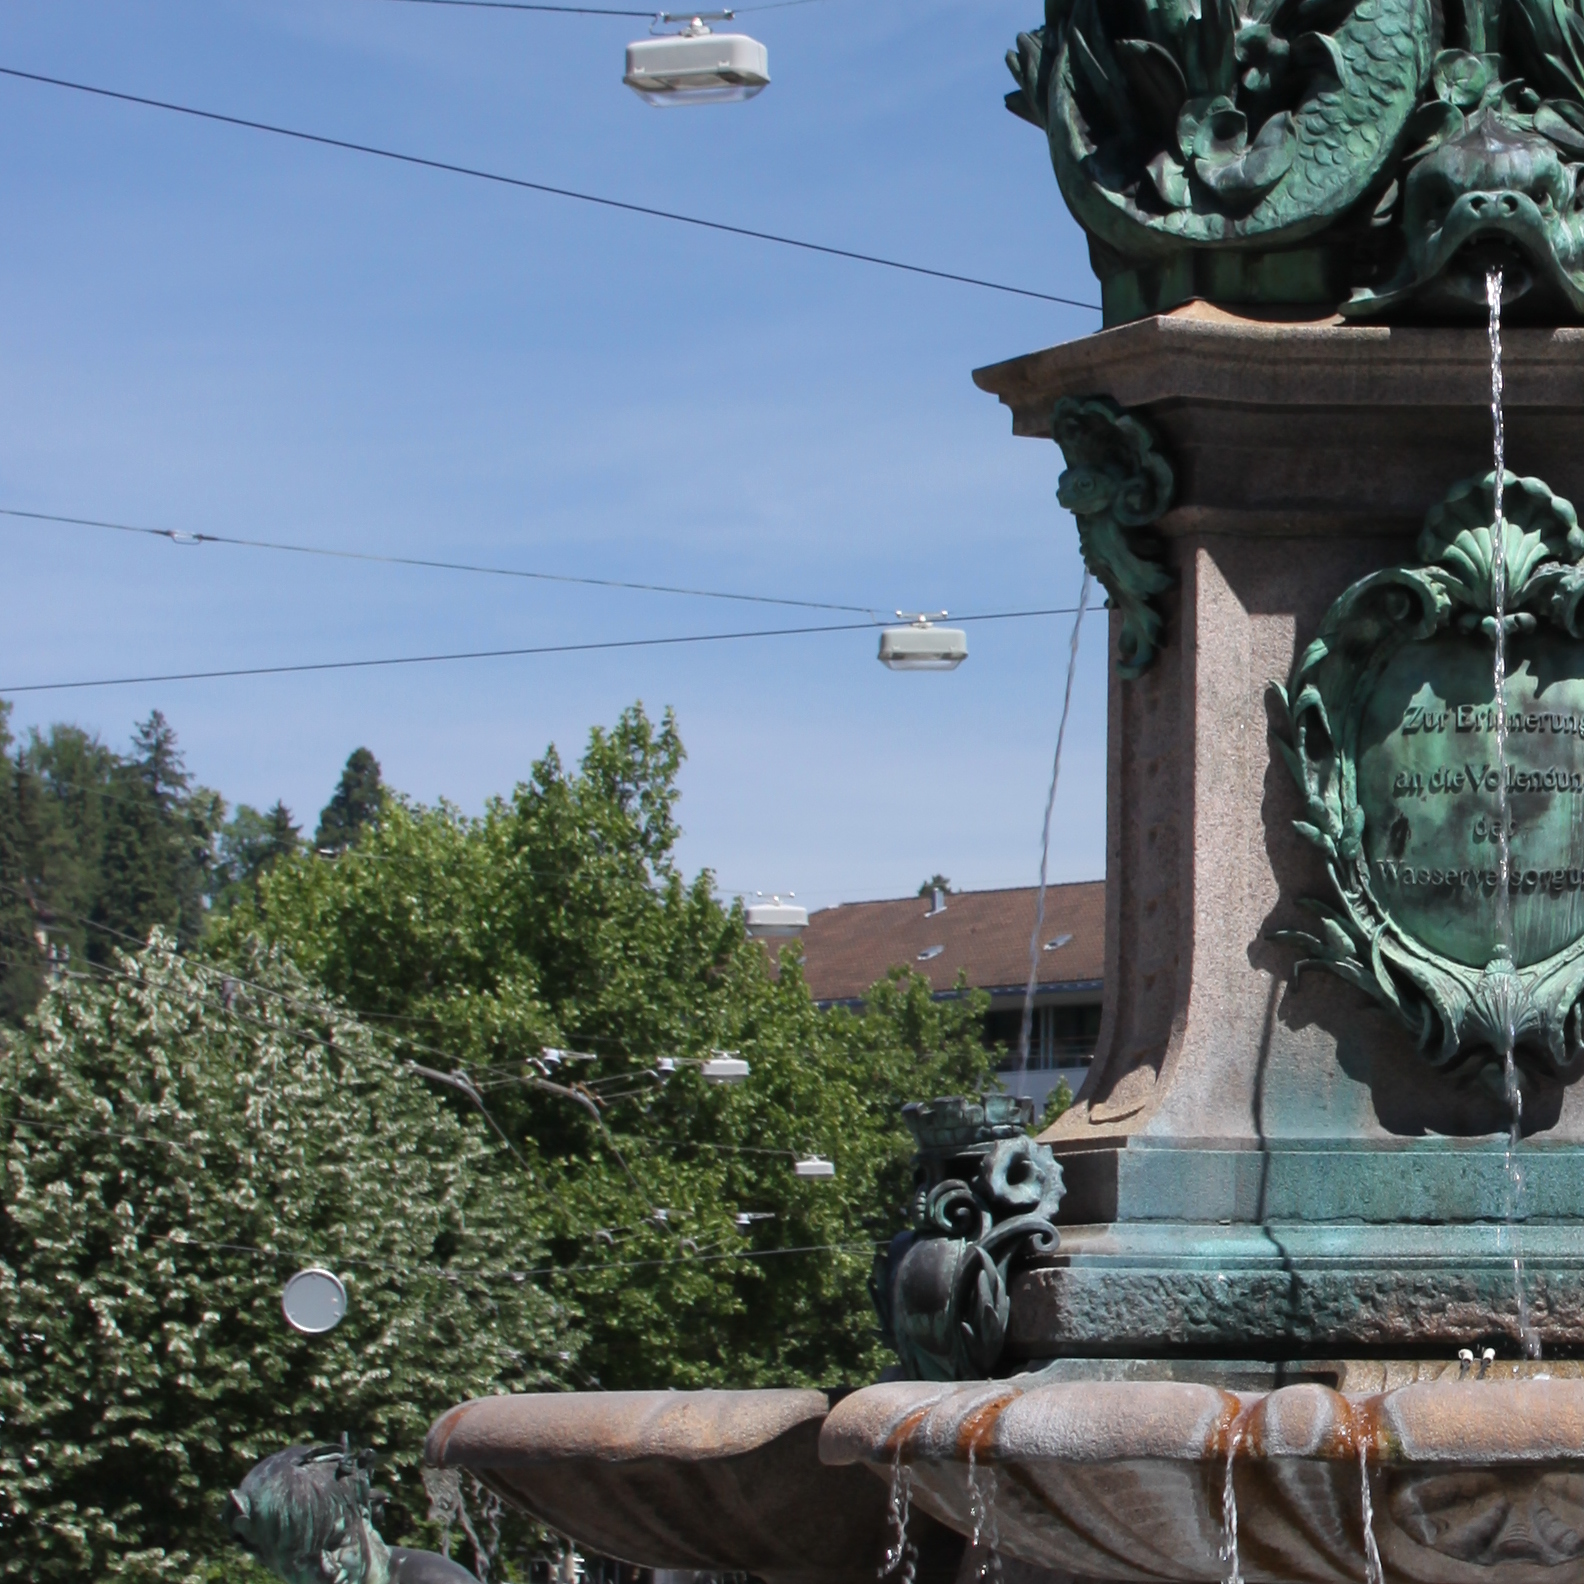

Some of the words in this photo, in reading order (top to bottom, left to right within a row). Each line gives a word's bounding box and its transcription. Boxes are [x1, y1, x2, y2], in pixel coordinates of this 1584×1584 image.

[1402, 705, 1448, 735] Zur
[1393, 770, 1423, 798] an
[1428, 765, 1464, 794] die
